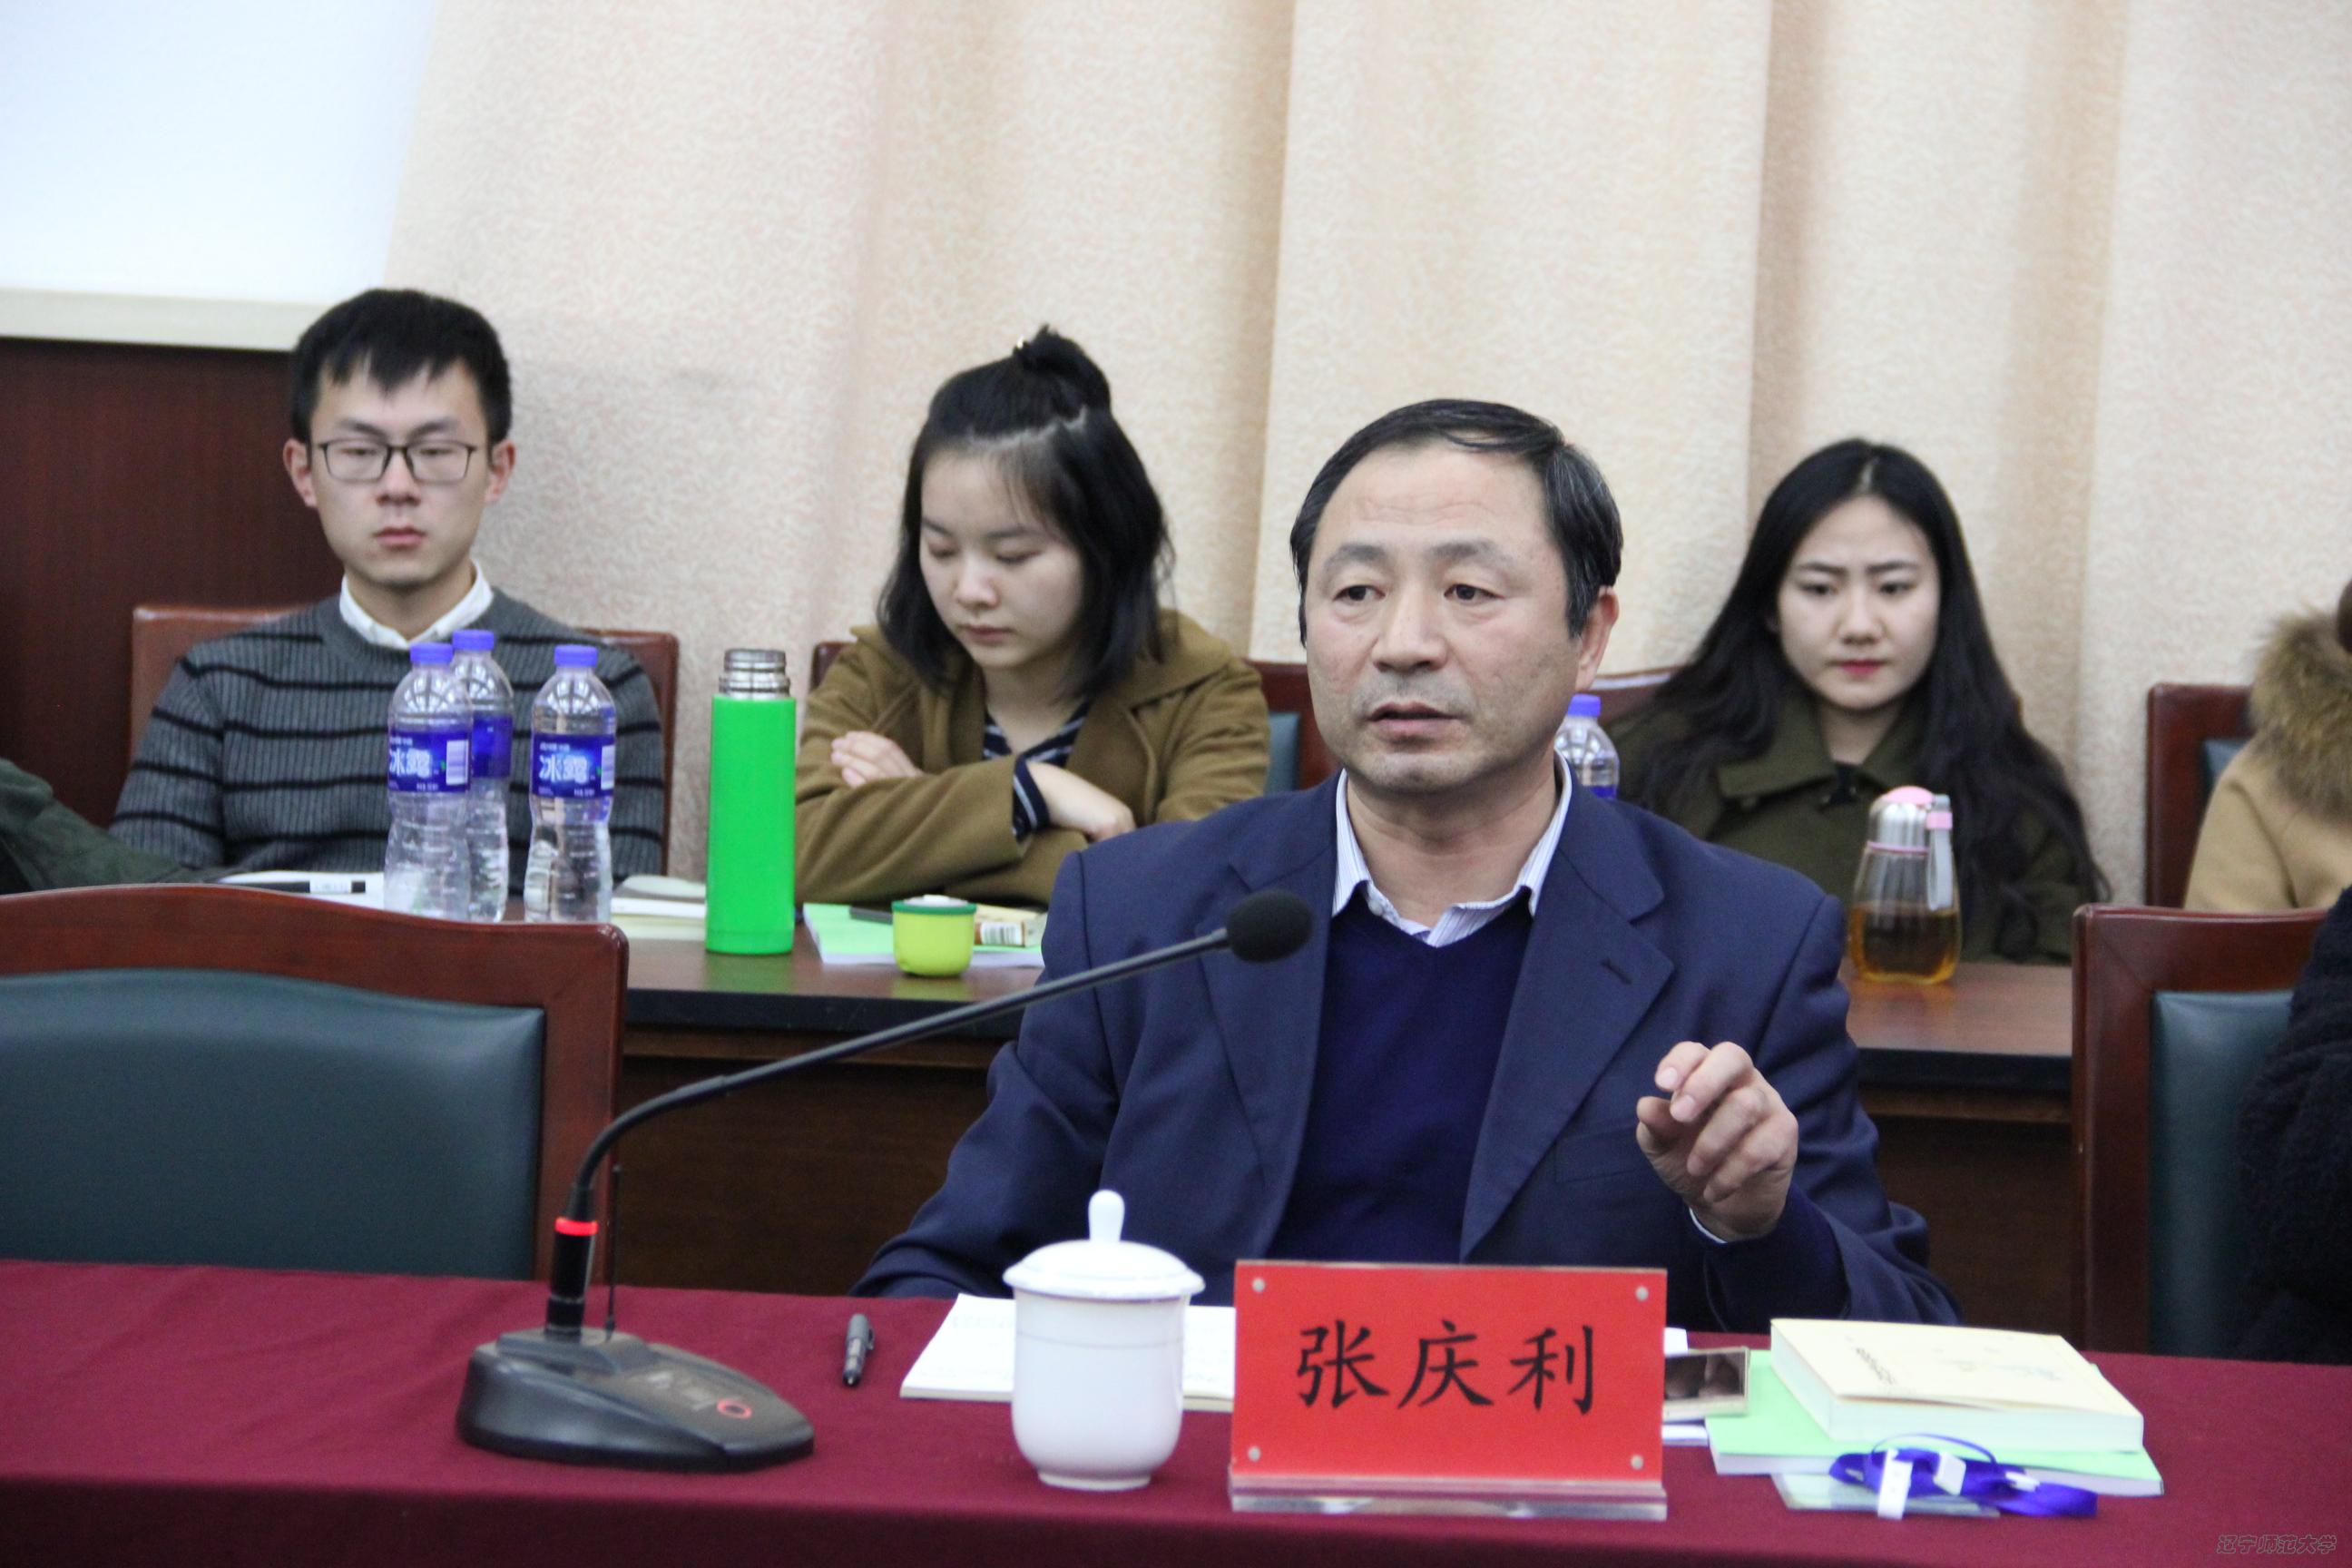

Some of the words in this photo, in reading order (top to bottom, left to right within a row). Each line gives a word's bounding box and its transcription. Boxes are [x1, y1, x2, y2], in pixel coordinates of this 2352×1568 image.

[538, 754, 588, 784] 冰露
[1296, 1318, 1594, 1416] 张庆利
